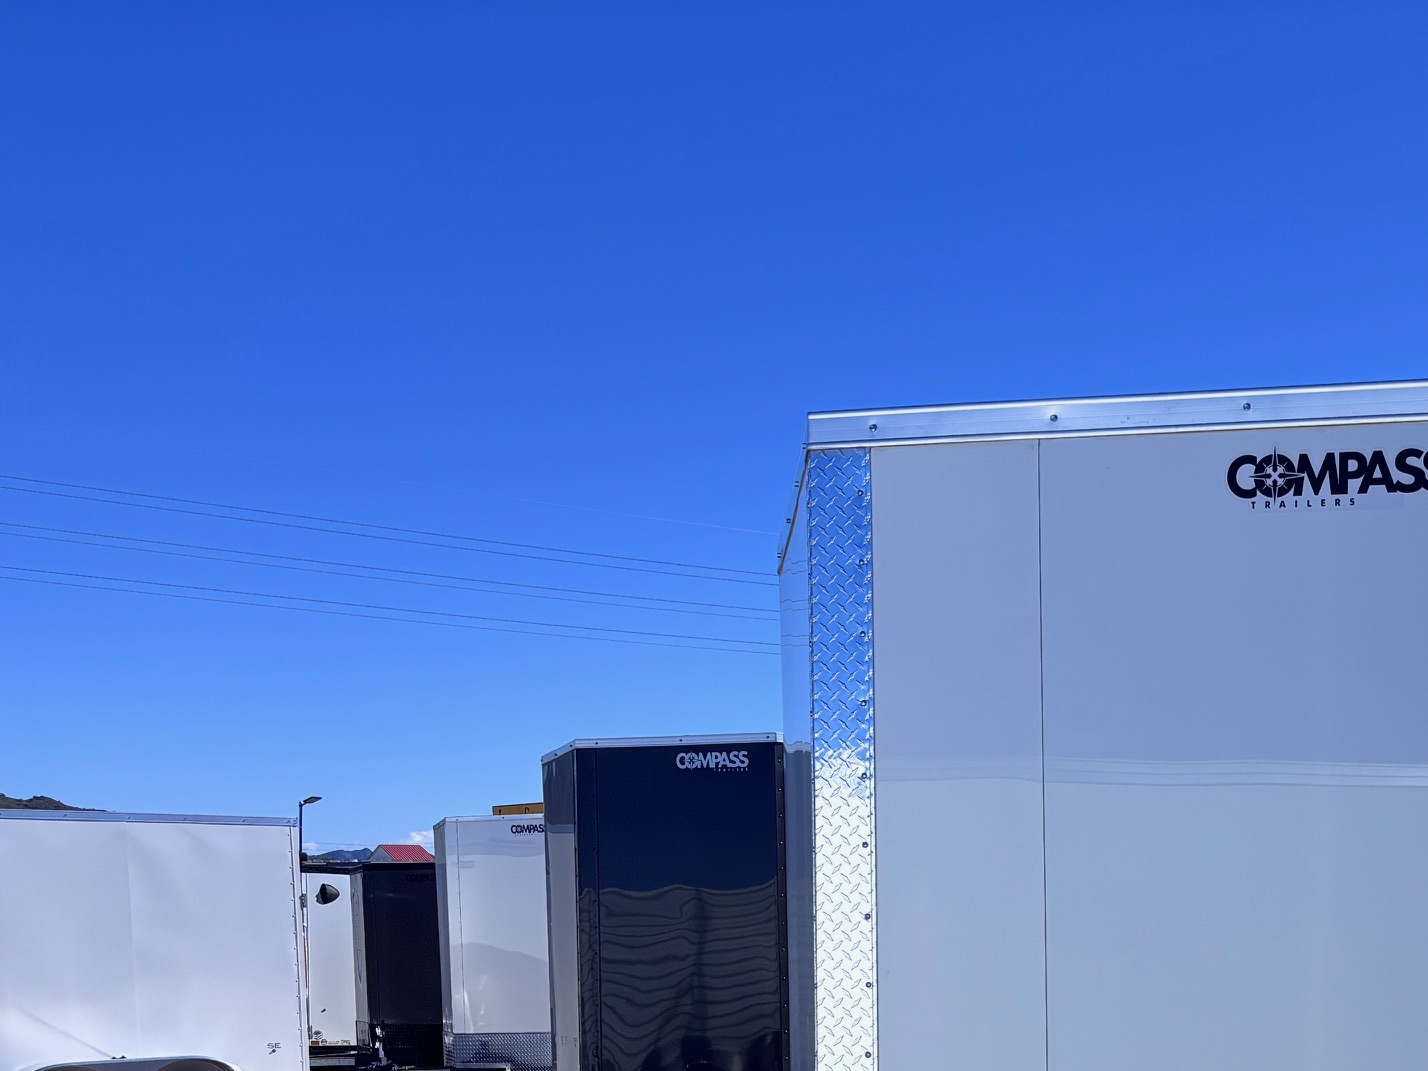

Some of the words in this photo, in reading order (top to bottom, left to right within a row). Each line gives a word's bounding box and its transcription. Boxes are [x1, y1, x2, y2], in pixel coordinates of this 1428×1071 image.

[1251, 498, 1356, 510] TRAILERS
[676, 750, 749, 770] COMPASS
[510, 824, 545, 834] COMPAS
